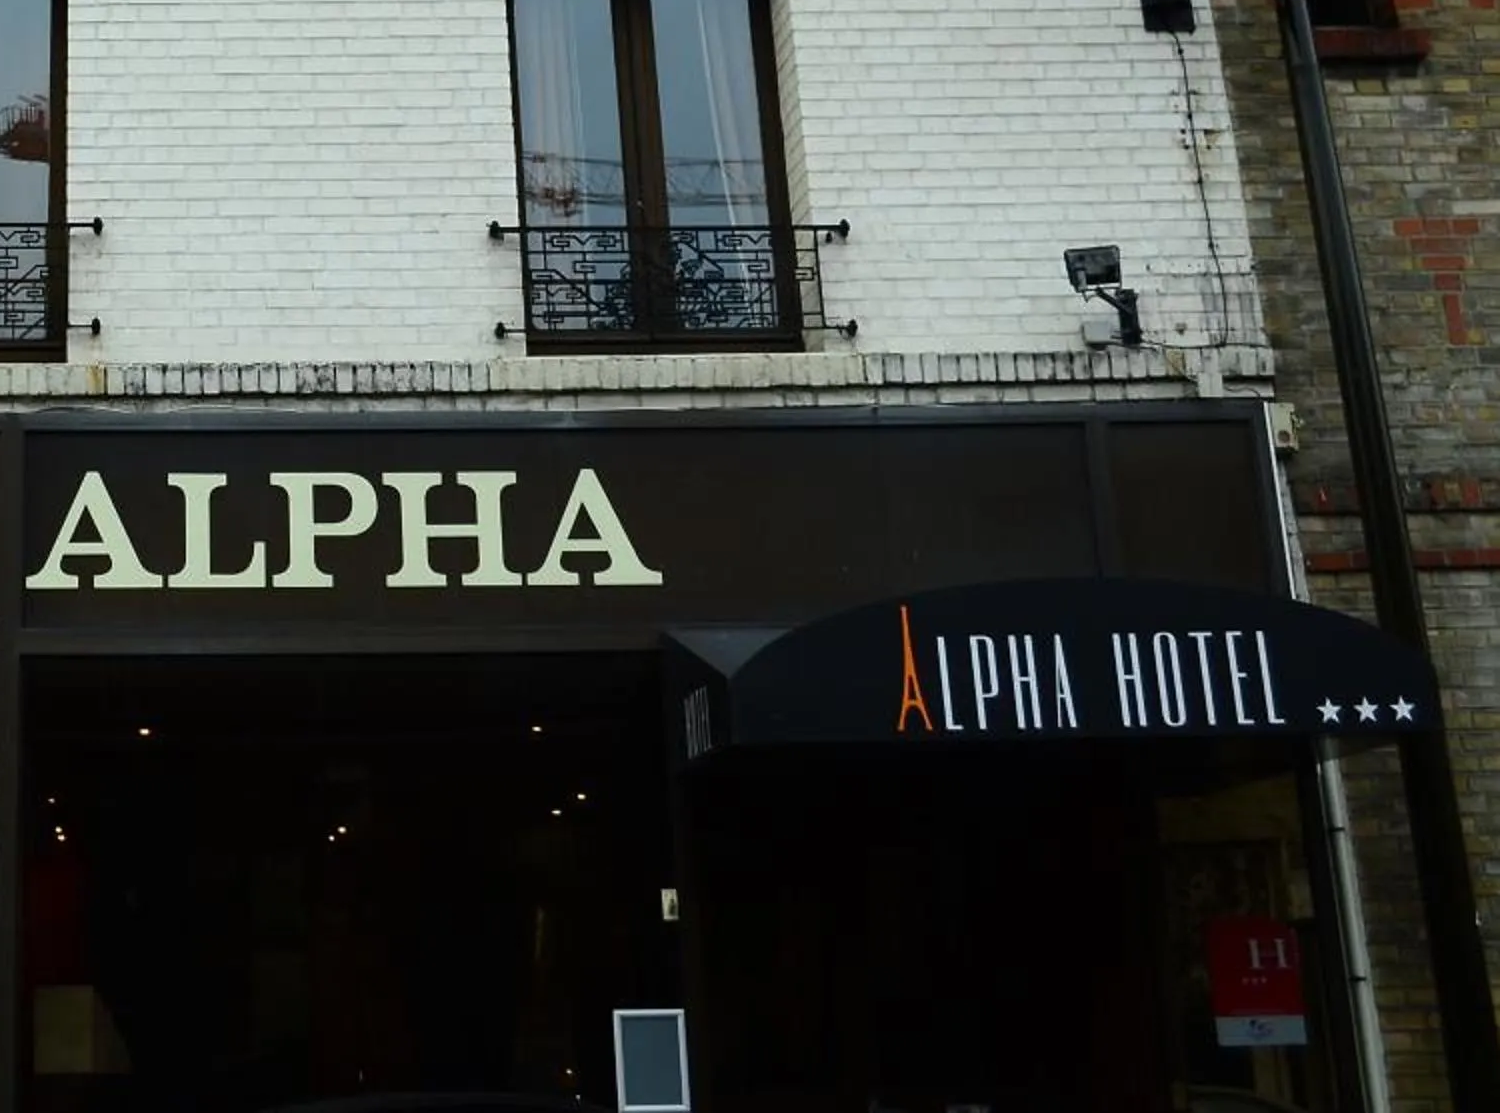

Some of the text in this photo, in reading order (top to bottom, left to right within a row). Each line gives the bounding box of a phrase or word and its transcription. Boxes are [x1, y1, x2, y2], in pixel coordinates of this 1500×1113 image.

[25, 468, 663, 589] ALPHA
[898, 605, 1286, 731] ALPHA HOTEL
[1248, 938, 1289, 969] H
